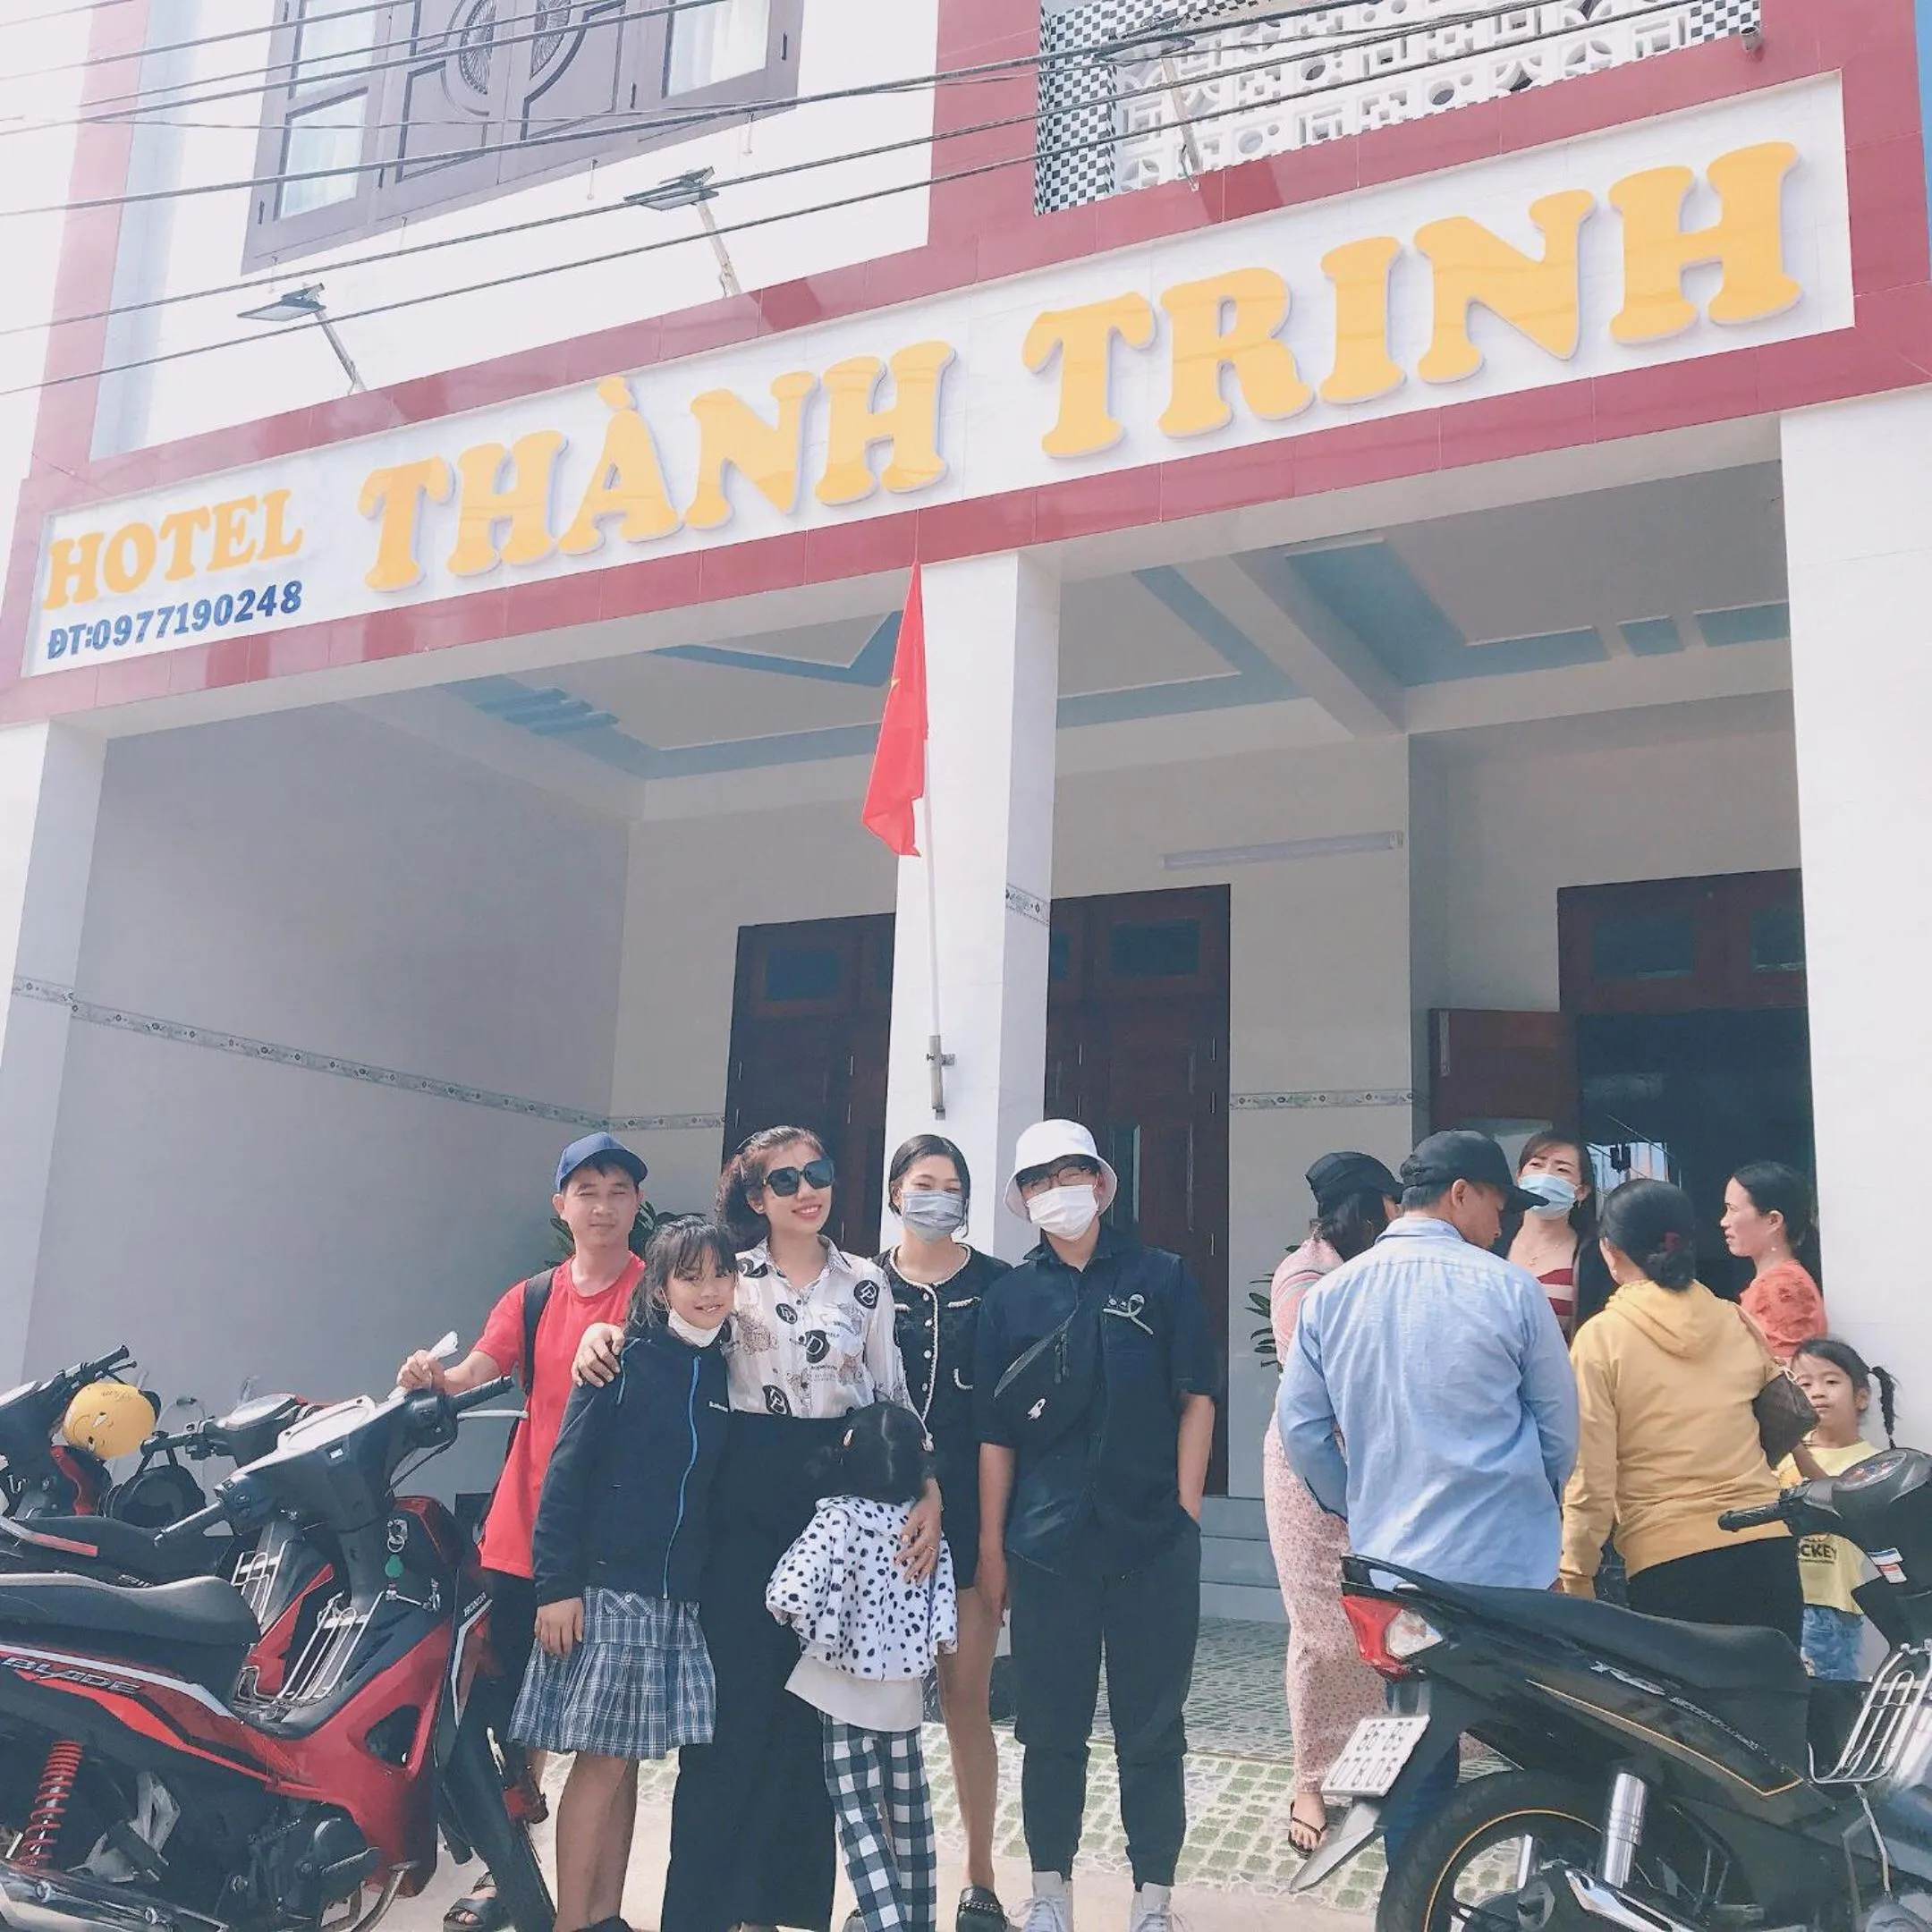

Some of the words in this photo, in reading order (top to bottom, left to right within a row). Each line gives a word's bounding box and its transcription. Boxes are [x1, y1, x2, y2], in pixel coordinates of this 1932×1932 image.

[42, 488, 303, 610] HOTEL
[359, 341, 954, 591] THÀNH
[1021, 141, 1802, 458] TRINH
[47, 580, 303, 659] ĐT:0977190248
[1800, 1543, 1837, 1560] CKEY
